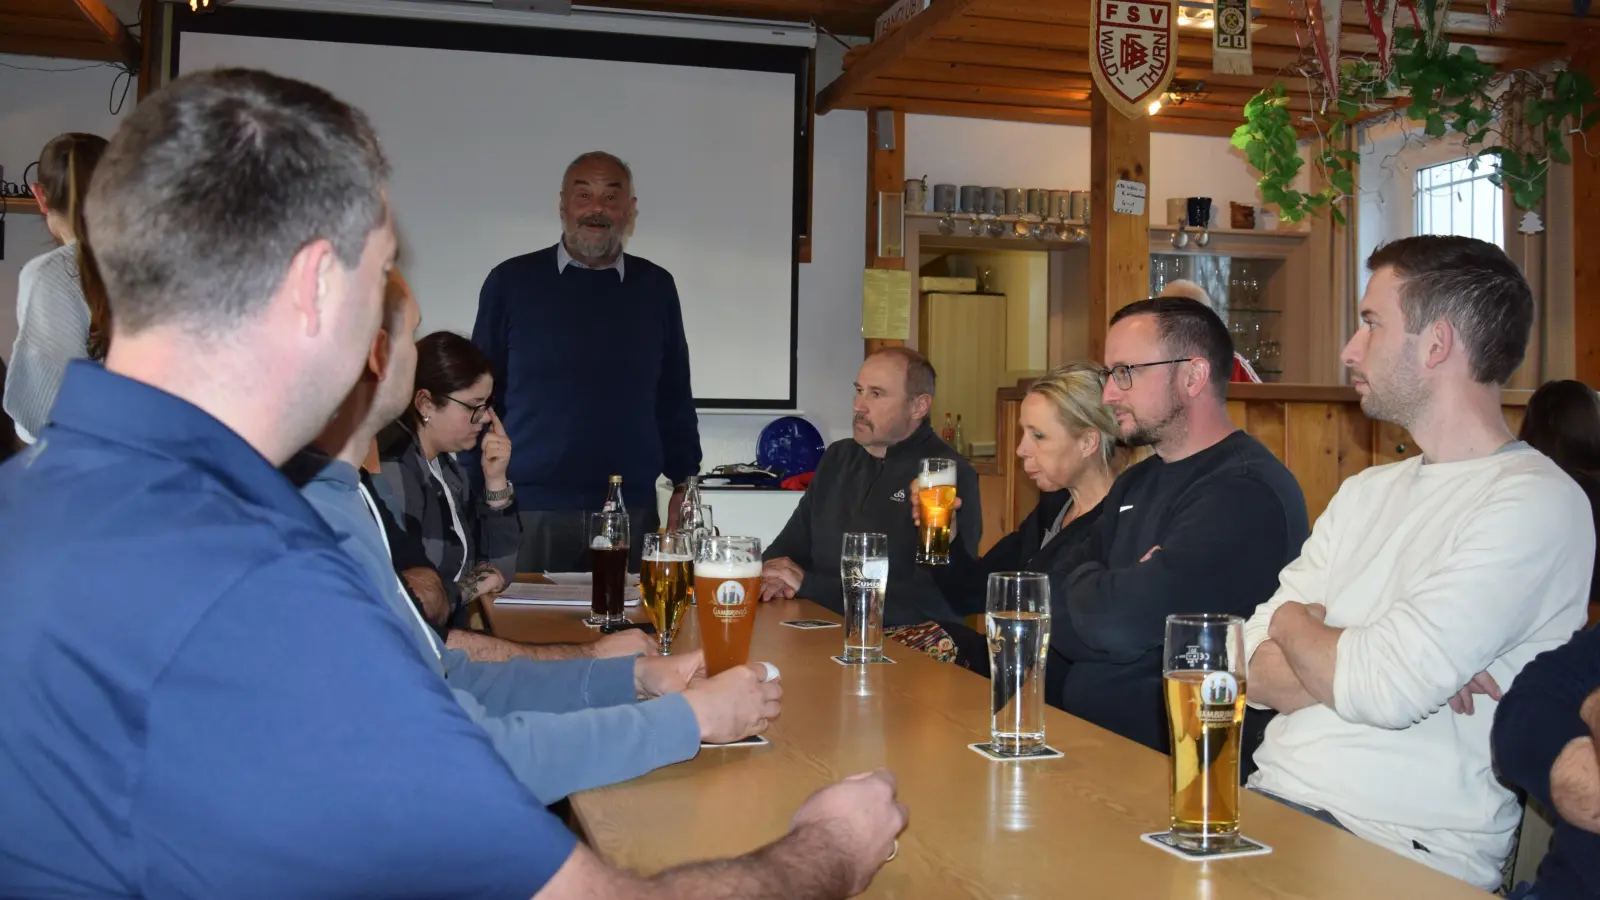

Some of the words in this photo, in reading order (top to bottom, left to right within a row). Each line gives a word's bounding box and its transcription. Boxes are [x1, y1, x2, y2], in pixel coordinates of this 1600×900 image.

[1106, 4, 1163, 24] FSV
[1100, 30, 1124, 85] WALD-
[1136, 33, 1167, 88] THURN
